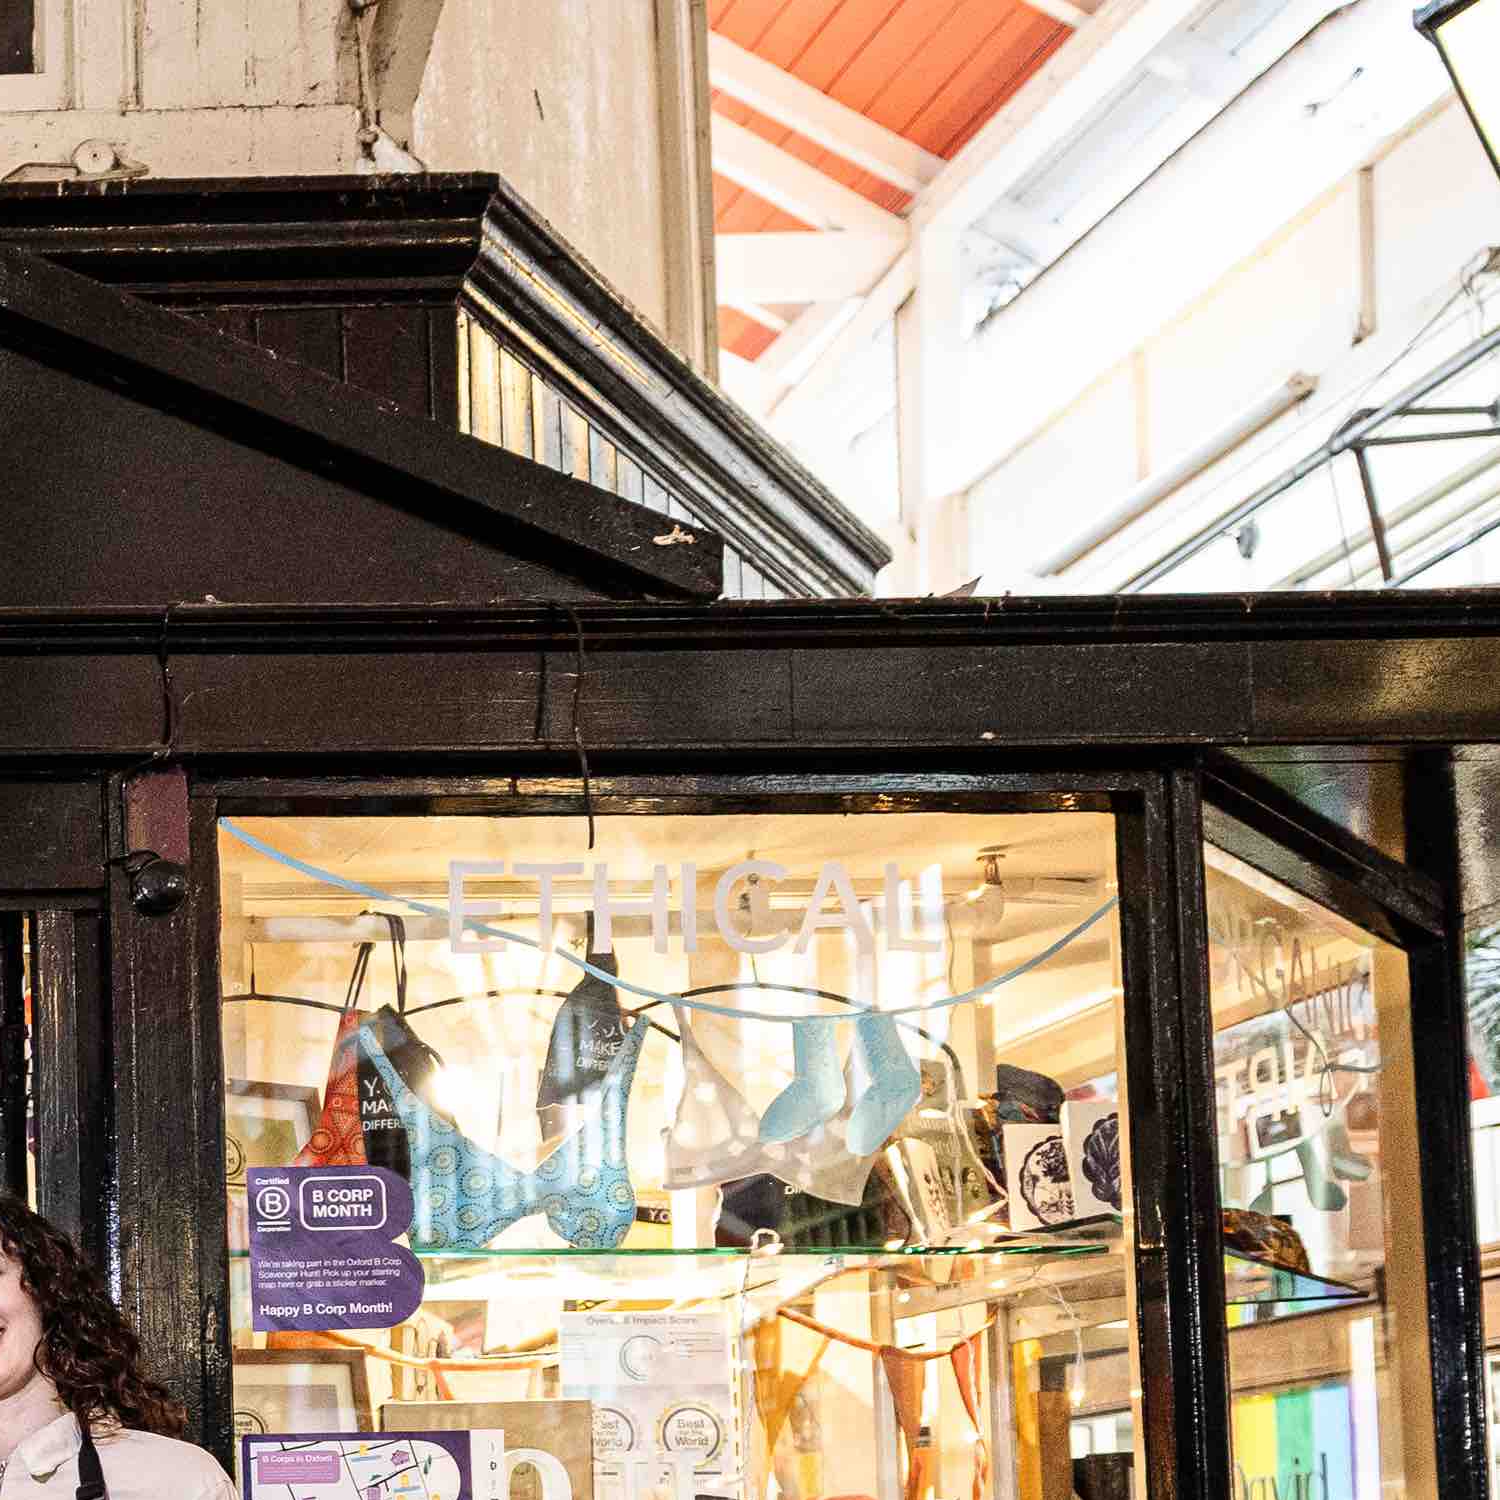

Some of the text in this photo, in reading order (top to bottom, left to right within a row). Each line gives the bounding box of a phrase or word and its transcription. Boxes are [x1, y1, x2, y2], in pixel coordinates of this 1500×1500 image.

[449, 860, 944, 955] ETHICAL
[255, 1177, 289, 1185] Certified
[312, 1189, 373, 1202] B CORP
[313, 1204, 372, 1217] MONTH
[282, 1260, 305, 1269] taking
[306, 1260, 322, 1268] part
[346, 1258, 372, 1266] Oxford
[383, 1258, 401, 1267] Corp
[258, 1271, 298, 1279] Scavenger
[323, 1269, 339, 1277] Pick
[354, 1270, 369, 1278] your
[372, 1268, 400, 1277] starting
[306, 1280, 324, 1289] grab
[332, 1279, 357, 1287] sticker
[260, 1302, 392, 1317] Happy B Corp Month!
[675, 1436, 709, 1446] World
